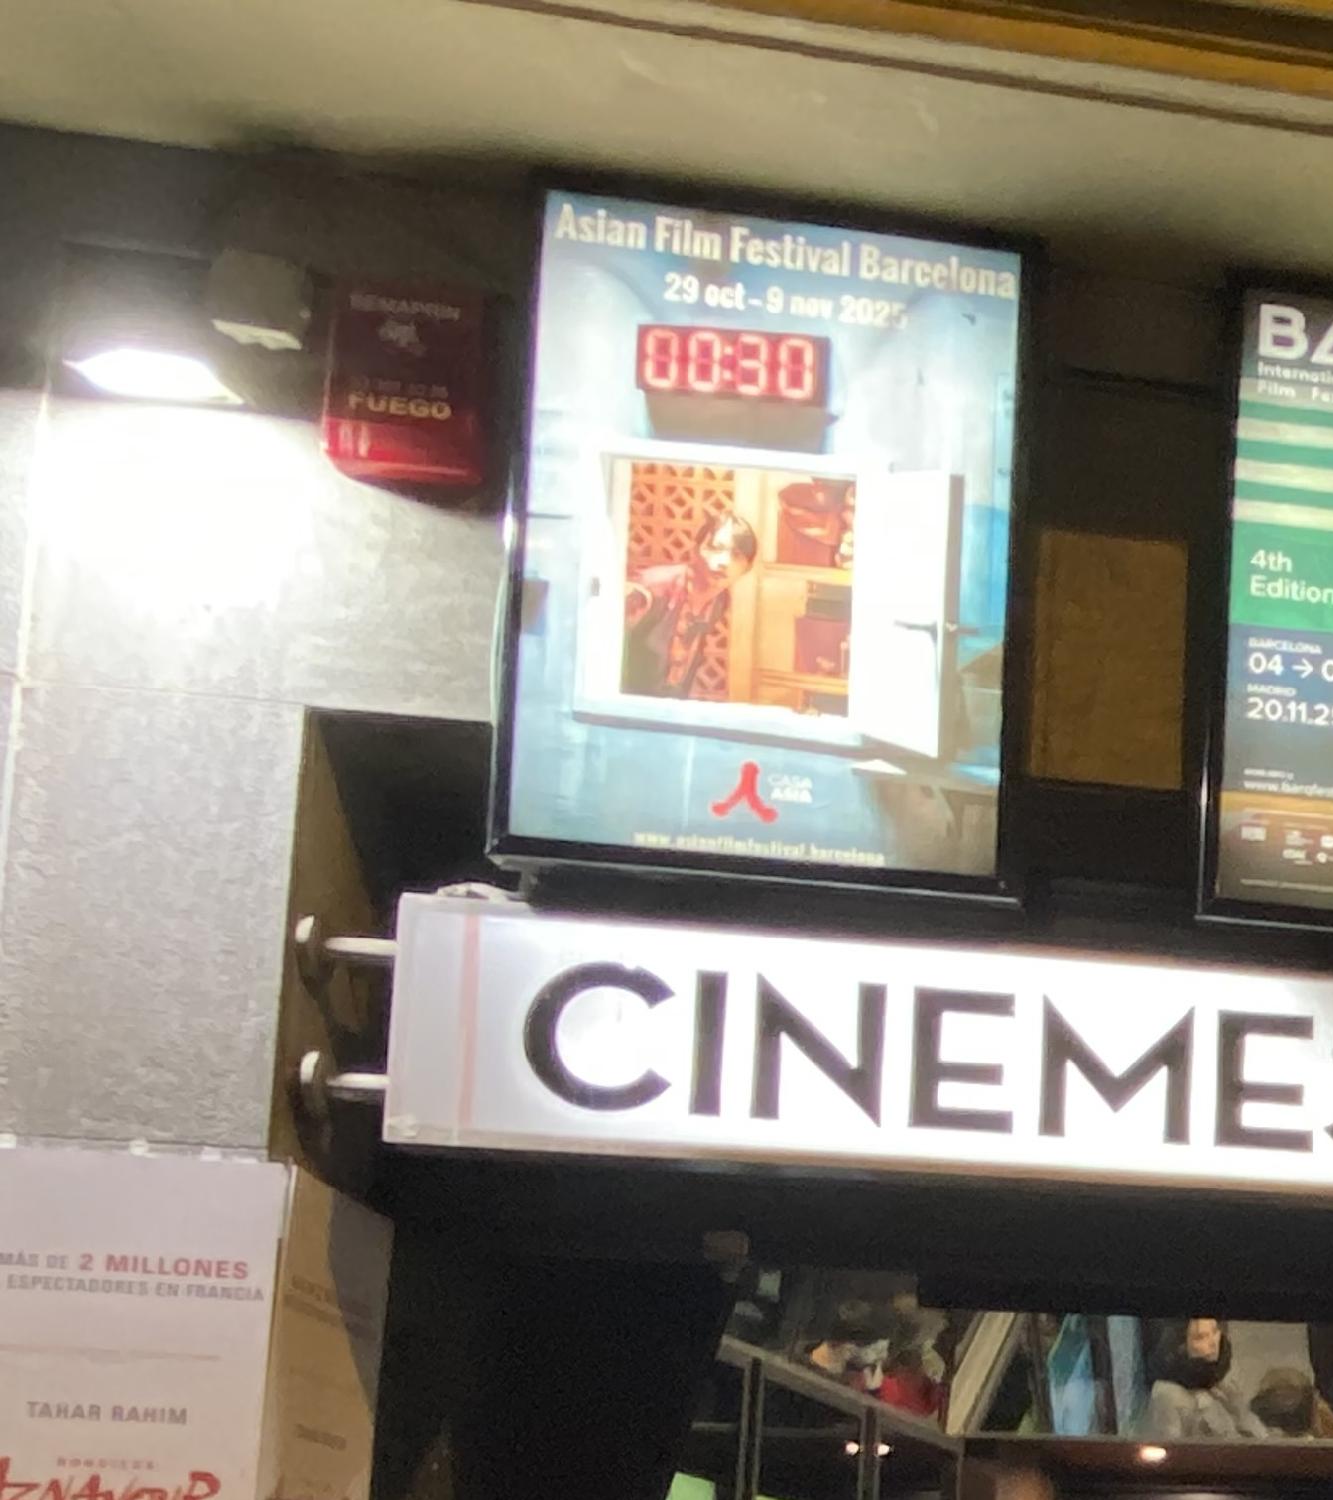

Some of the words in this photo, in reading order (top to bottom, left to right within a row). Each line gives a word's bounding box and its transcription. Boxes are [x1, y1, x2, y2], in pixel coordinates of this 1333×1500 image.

[555, 204, 647, 251] Asian
[654, 211, 721, 261] Film
[730, 226, 850, 277] Festival
[858, 243, 1016, 299] Barcelona
[664, 272, 700, 304] 29
[704, 282, 746, 311] oct
[790, 295, 834, 318] nov
[838, 294, 909, 329] 2025
[643, 329, 815, 400] 00:30
[1257, 380, 1296, 399] Film
[348, 393, 452, 420] FUEGO
[1250, 548, 1292, 574] 4th
[1249, 652, 1285, 676] 04
[46, 1253, 68, 1270] DE
[78, 1253, 95, 1272] 2
[105, 1253, 249, 1281] MILLONES
[6, 1273, 150, 1297] ESPECTADORES
[155, 1281, 180, 1298] EN
[186, 1283, 265, 1302] FRANCIA
[27, 1400, 101, 1422] TAHAR
[111, 1403, 188, 1426] RAHIM
